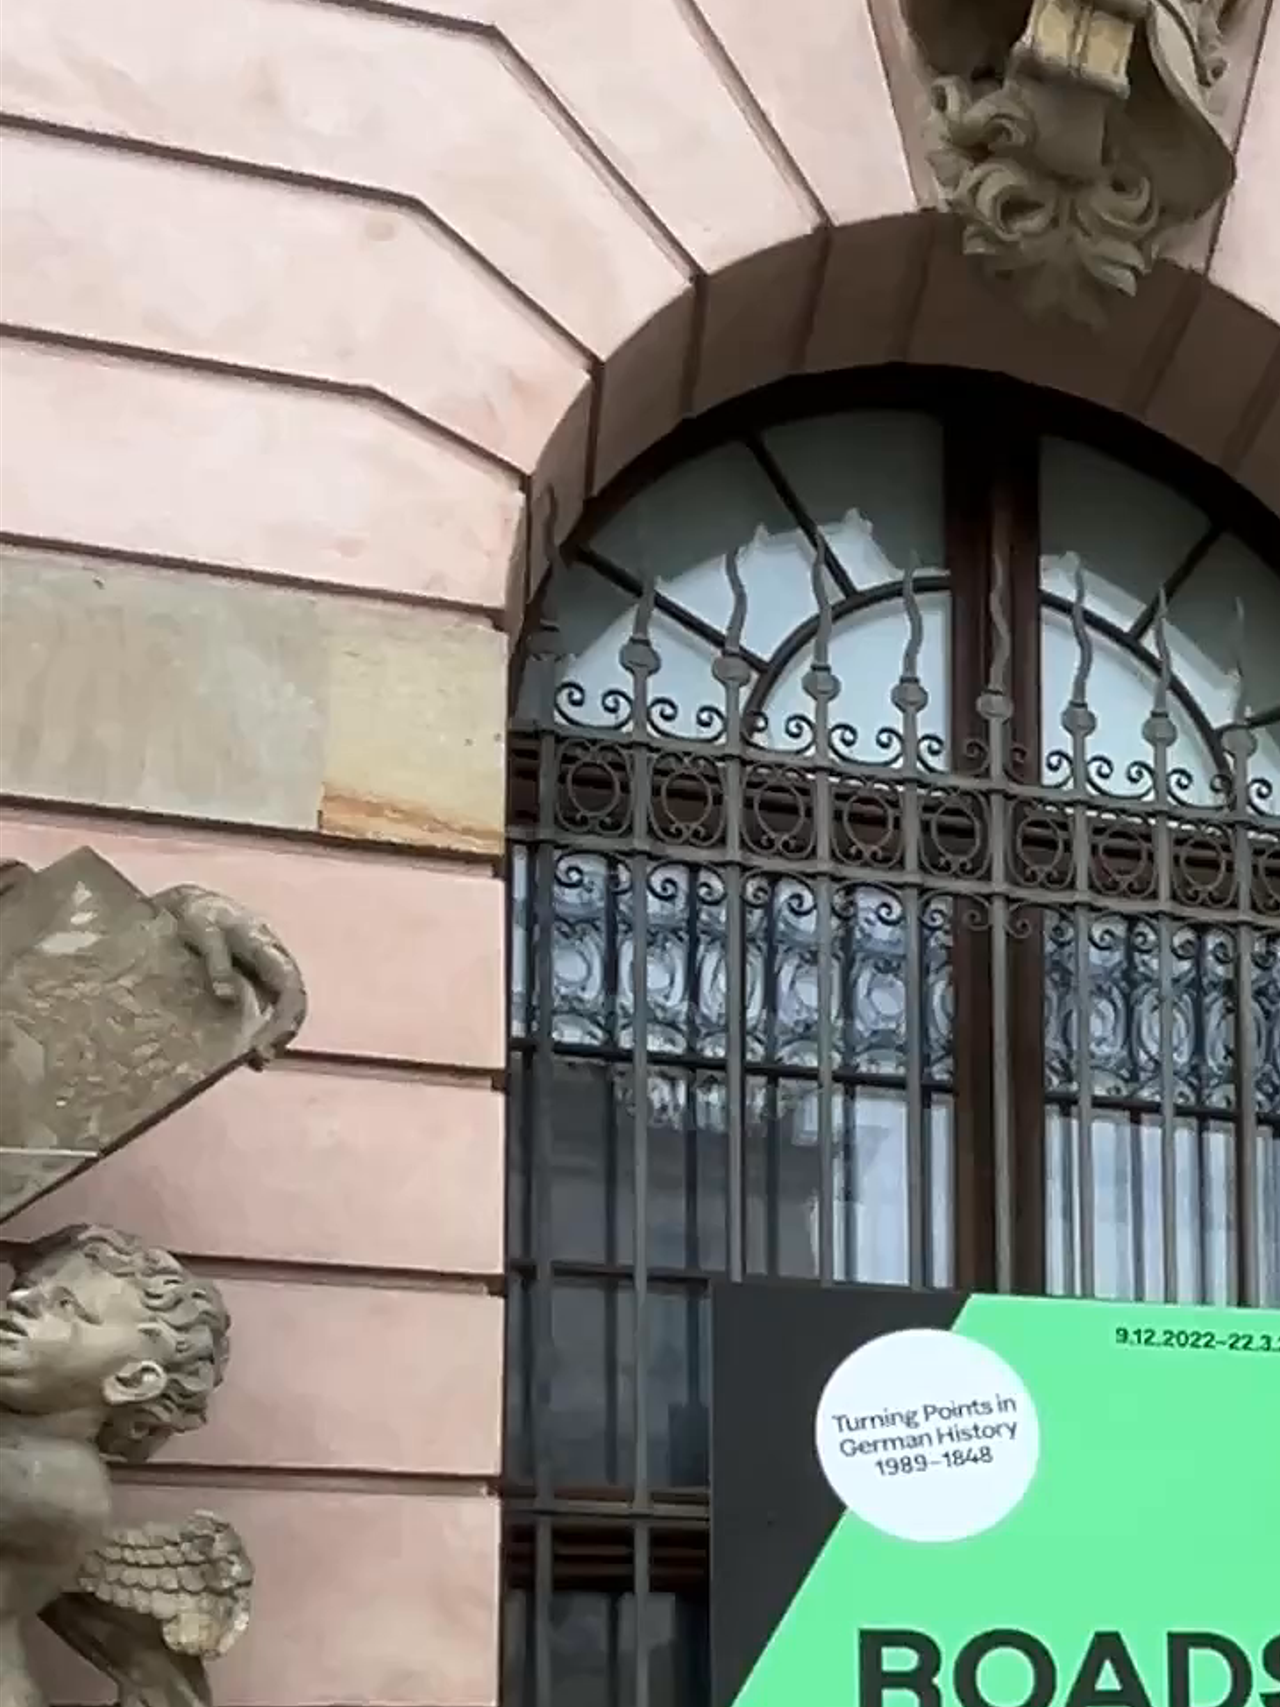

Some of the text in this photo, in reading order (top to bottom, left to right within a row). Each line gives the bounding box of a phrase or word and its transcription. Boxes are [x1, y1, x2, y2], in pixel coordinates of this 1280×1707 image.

[832, 1393, 1017, 1433] Turning Points in
[839, 1421, 1018, 1457] German History
[875, 1445, 993, 1476] 1989–1848
